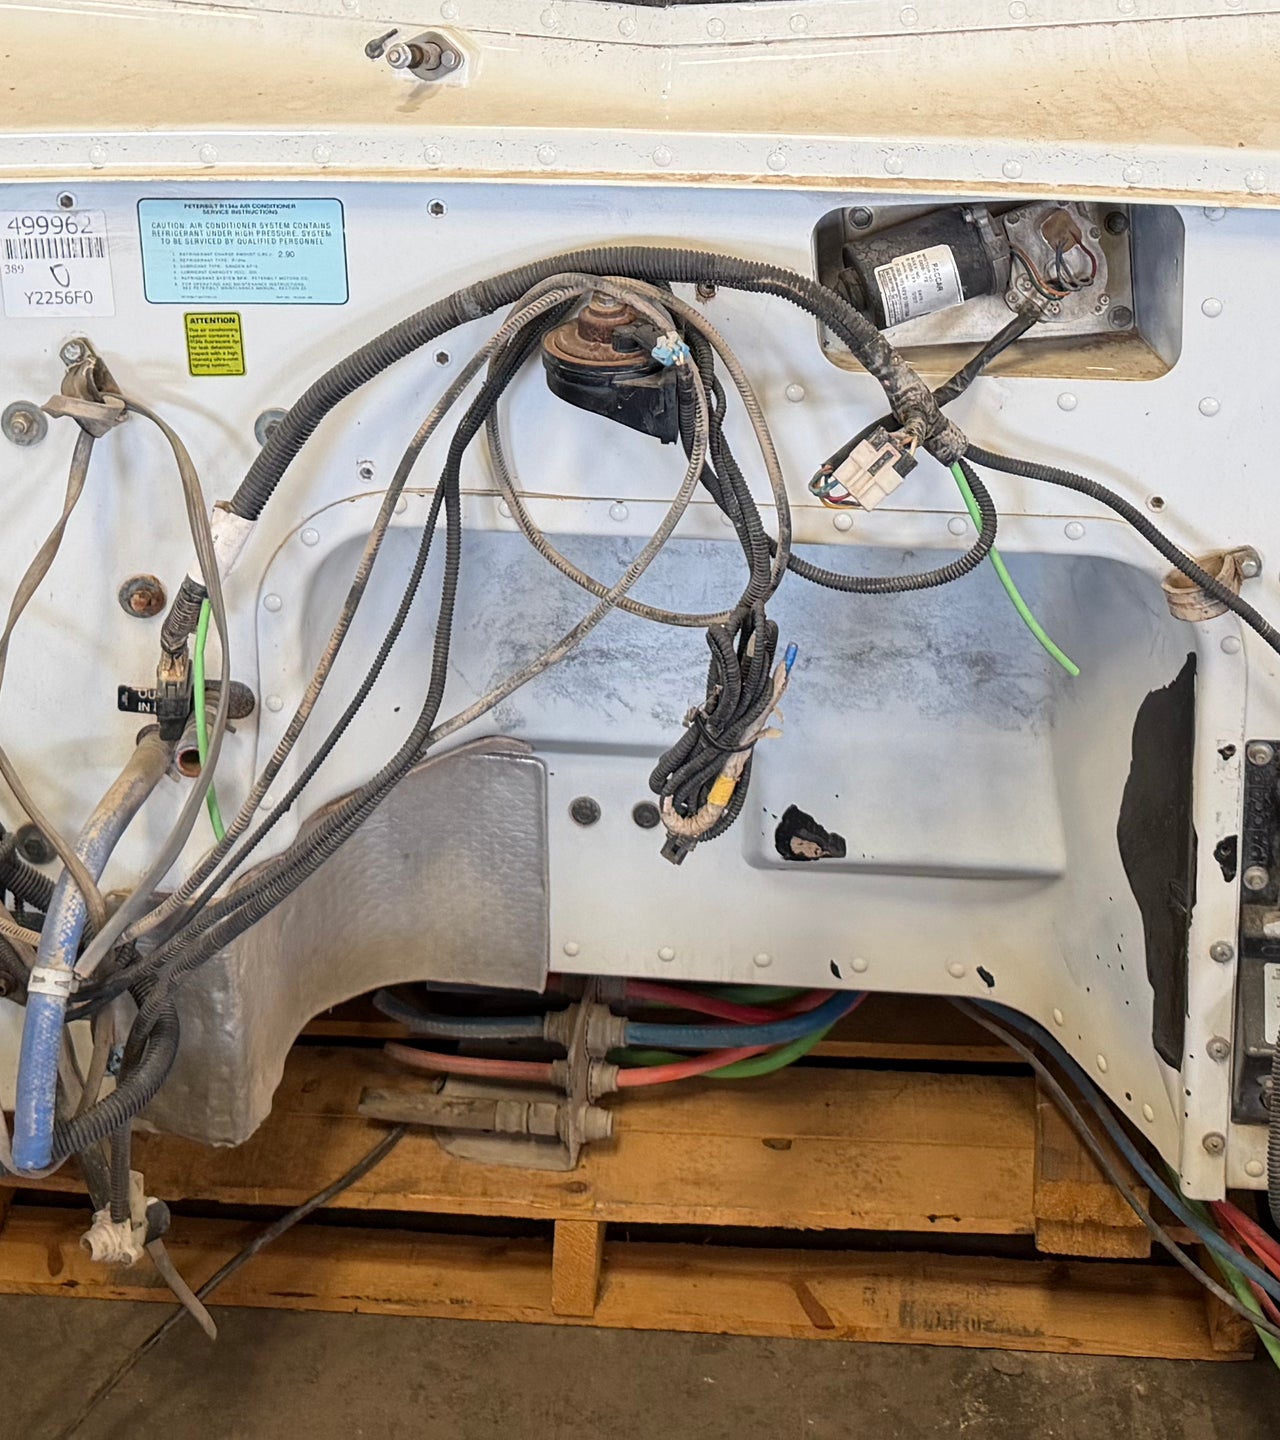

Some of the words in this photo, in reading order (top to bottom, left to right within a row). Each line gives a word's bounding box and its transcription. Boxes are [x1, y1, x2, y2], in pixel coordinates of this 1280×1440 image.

[7, 215, 93, 236] 499962
[277, 250, 296, 258] 2.90
[932, 262, 944, 292] PACCAR
[24, 290, 94, 305] Y2256F0
